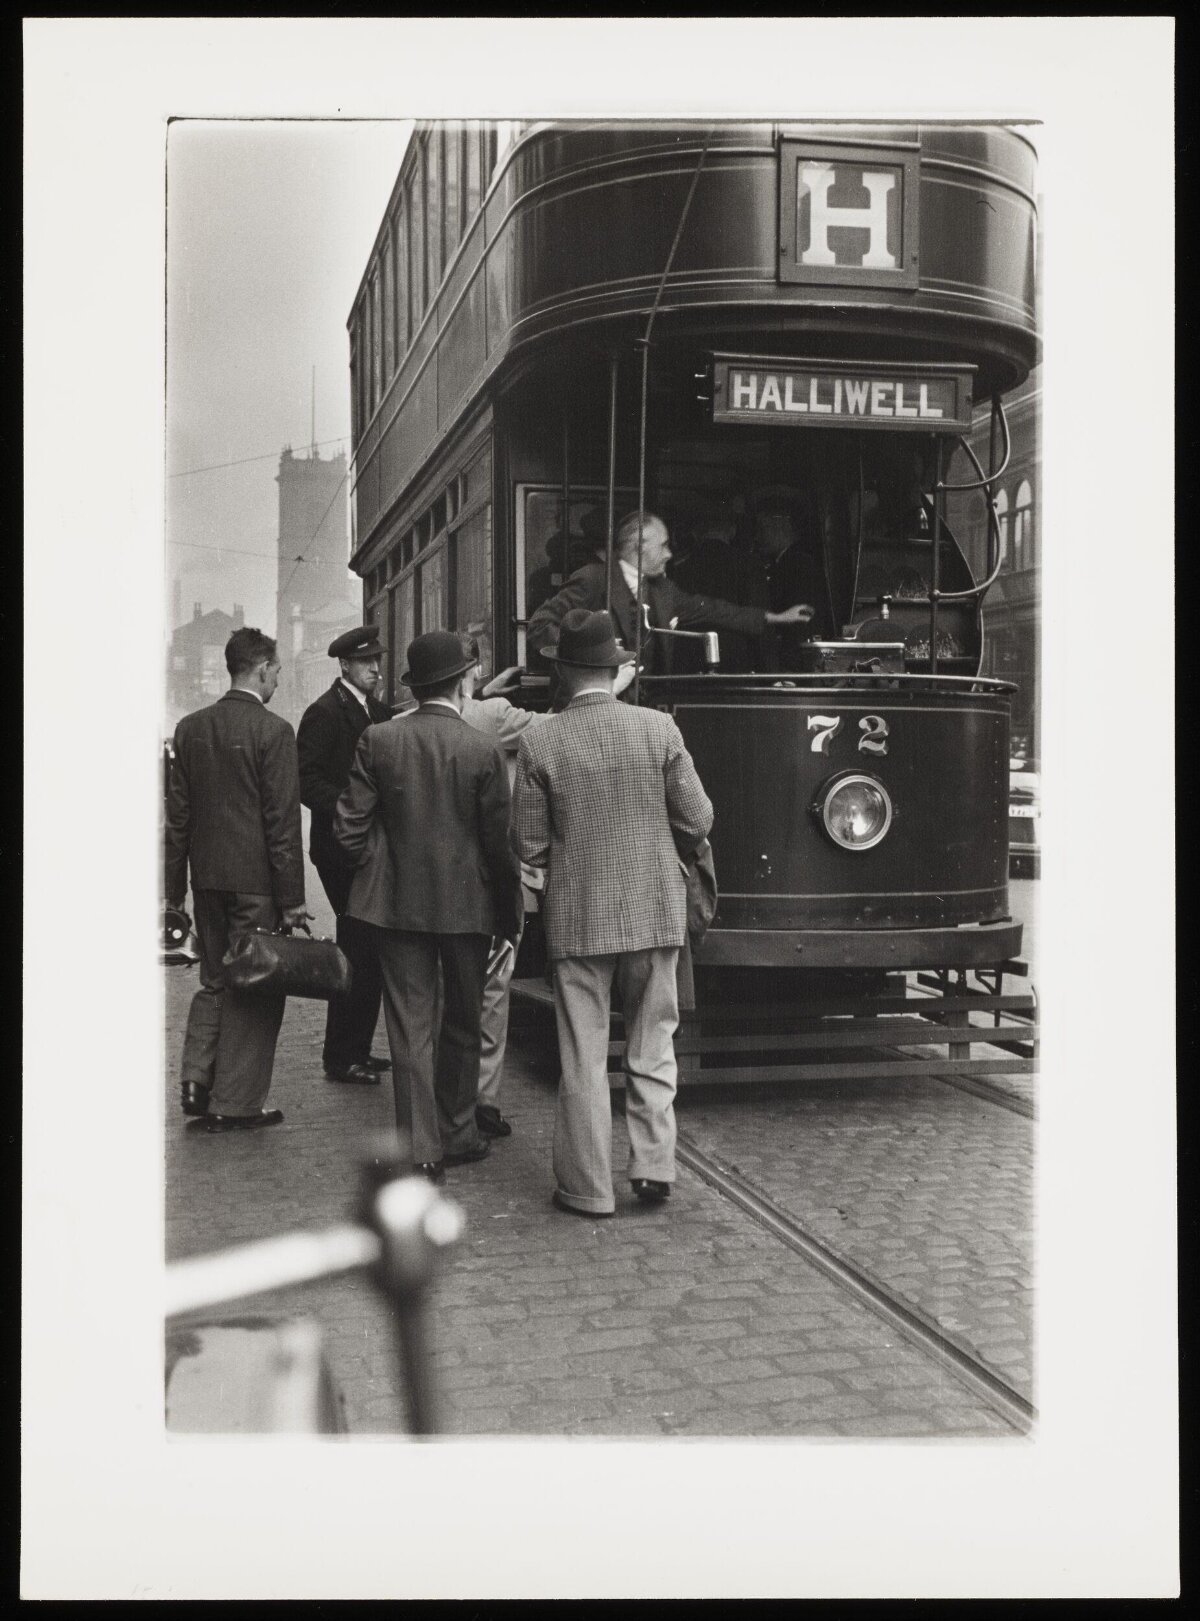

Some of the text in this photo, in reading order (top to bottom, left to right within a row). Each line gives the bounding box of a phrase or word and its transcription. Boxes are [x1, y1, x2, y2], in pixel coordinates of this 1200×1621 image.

[802, 169, 896, 267] H
[733, 374, 943, 418] HALLIWELL
[807, 715, 889, 756] 72
